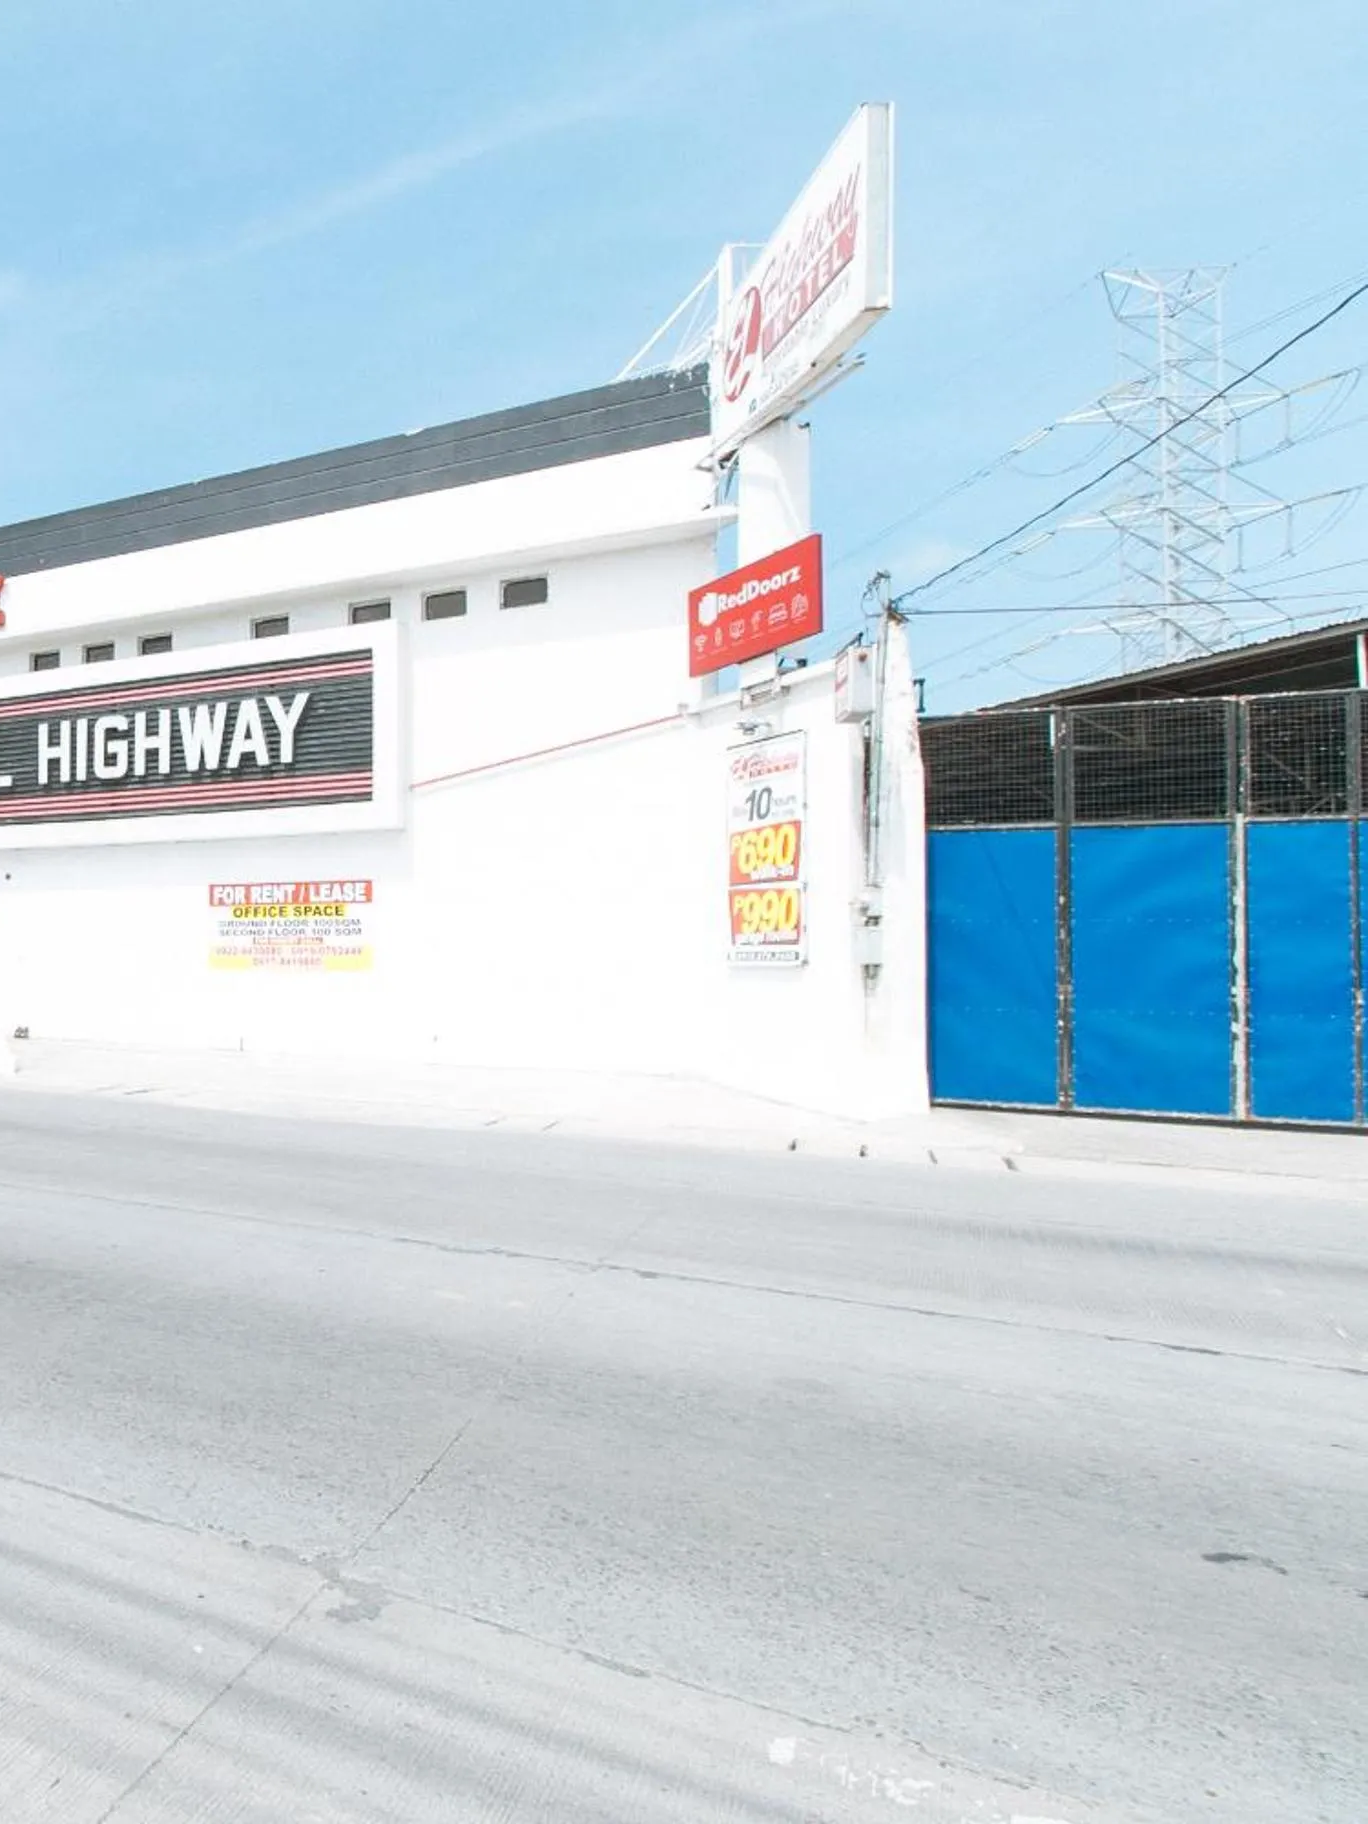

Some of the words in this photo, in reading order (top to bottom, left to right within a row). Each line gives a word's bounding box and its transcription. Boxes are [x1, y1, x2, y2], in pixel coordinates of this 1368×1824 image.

[717, 564, 802, 613] RedDoorz
[37, 692, 310, 785] HIGHWAY
[744, 785, 774, 822] 10
[211, 885, 245, 905] FOR
[250, 884, 295, 904] RENT
[309, 882, 367, 903] LEASE
[233, 905, 289, 918] OFFICE
[293, 905, 345, 917] SPACE
[219, 928, 266, 936] SECOND
[268, 928, 306, 936] FLOOR
